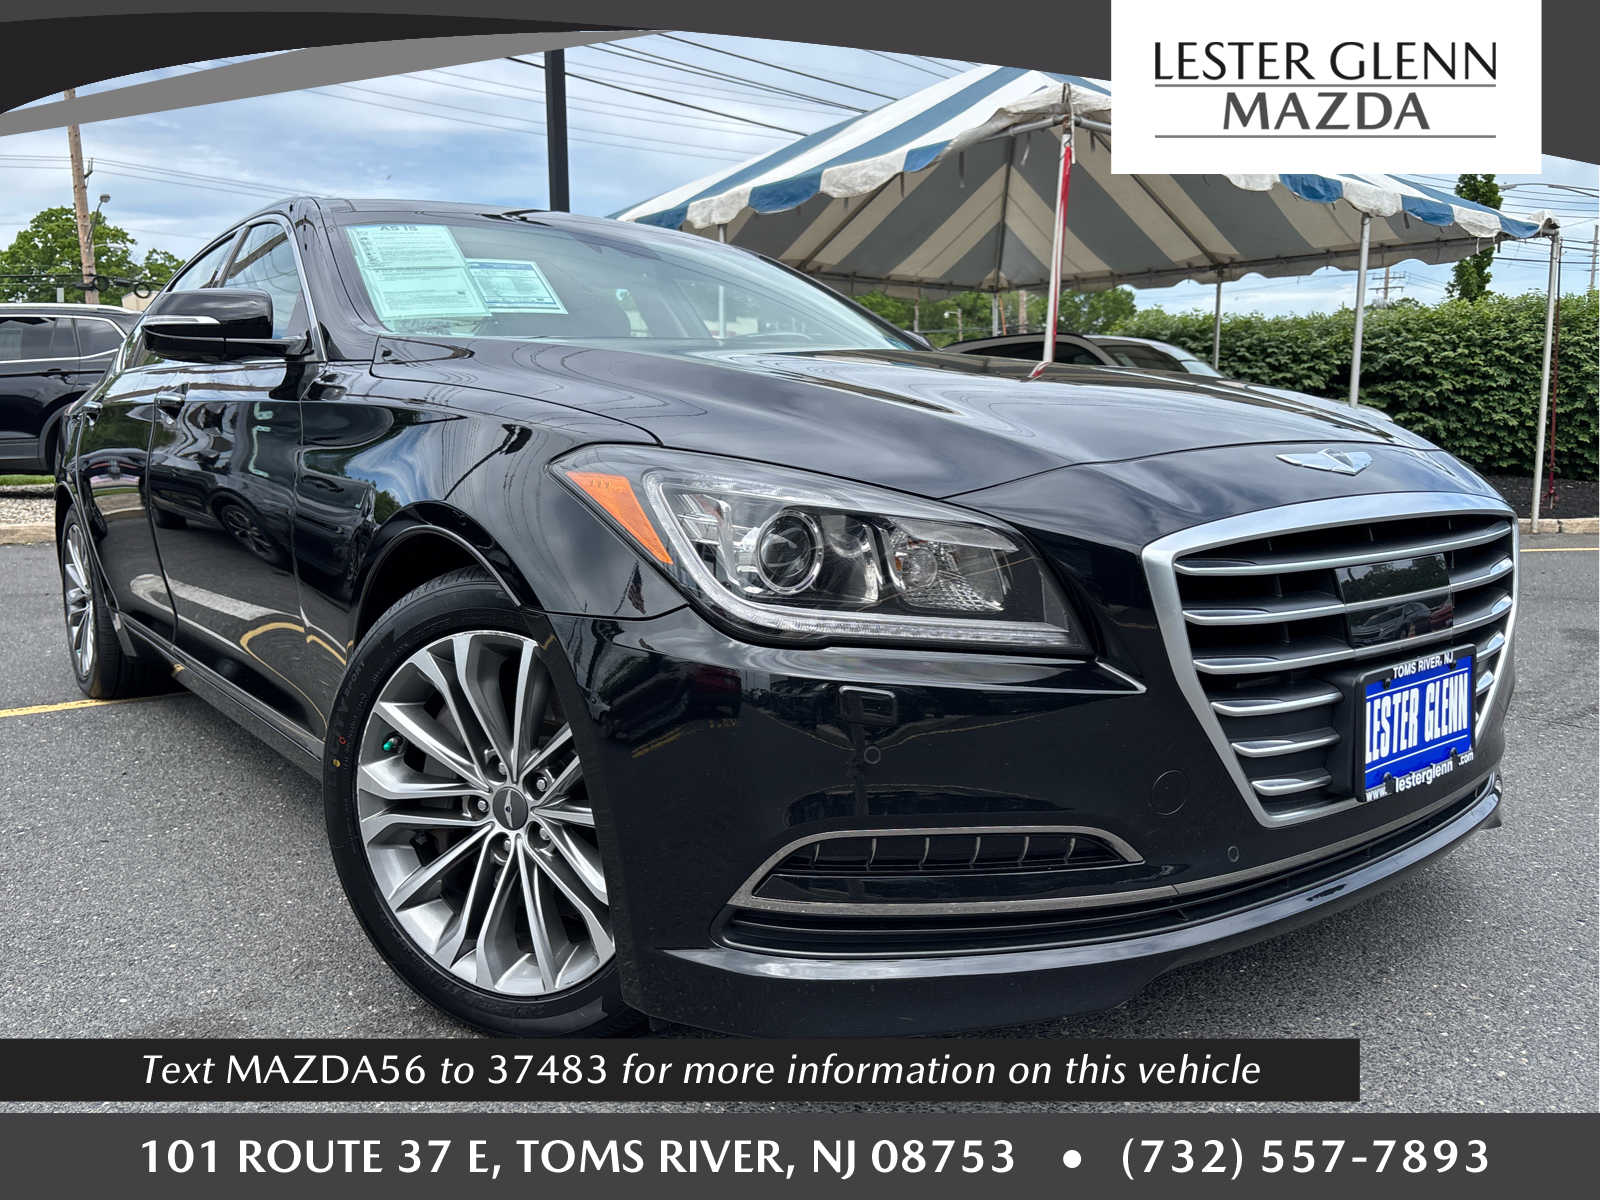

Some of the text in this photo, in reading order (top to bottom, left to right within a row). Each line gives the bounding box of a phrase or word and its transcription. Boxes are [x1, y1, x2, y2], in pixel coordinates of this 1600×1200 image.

[1393, 661, 1417, 679] TOMS
[1444, 652, 1454, 665] NJ
[1365, 672, 1469, 764] LESTER GLENN
[1394, 760, 1454, 793] lesterglenn
